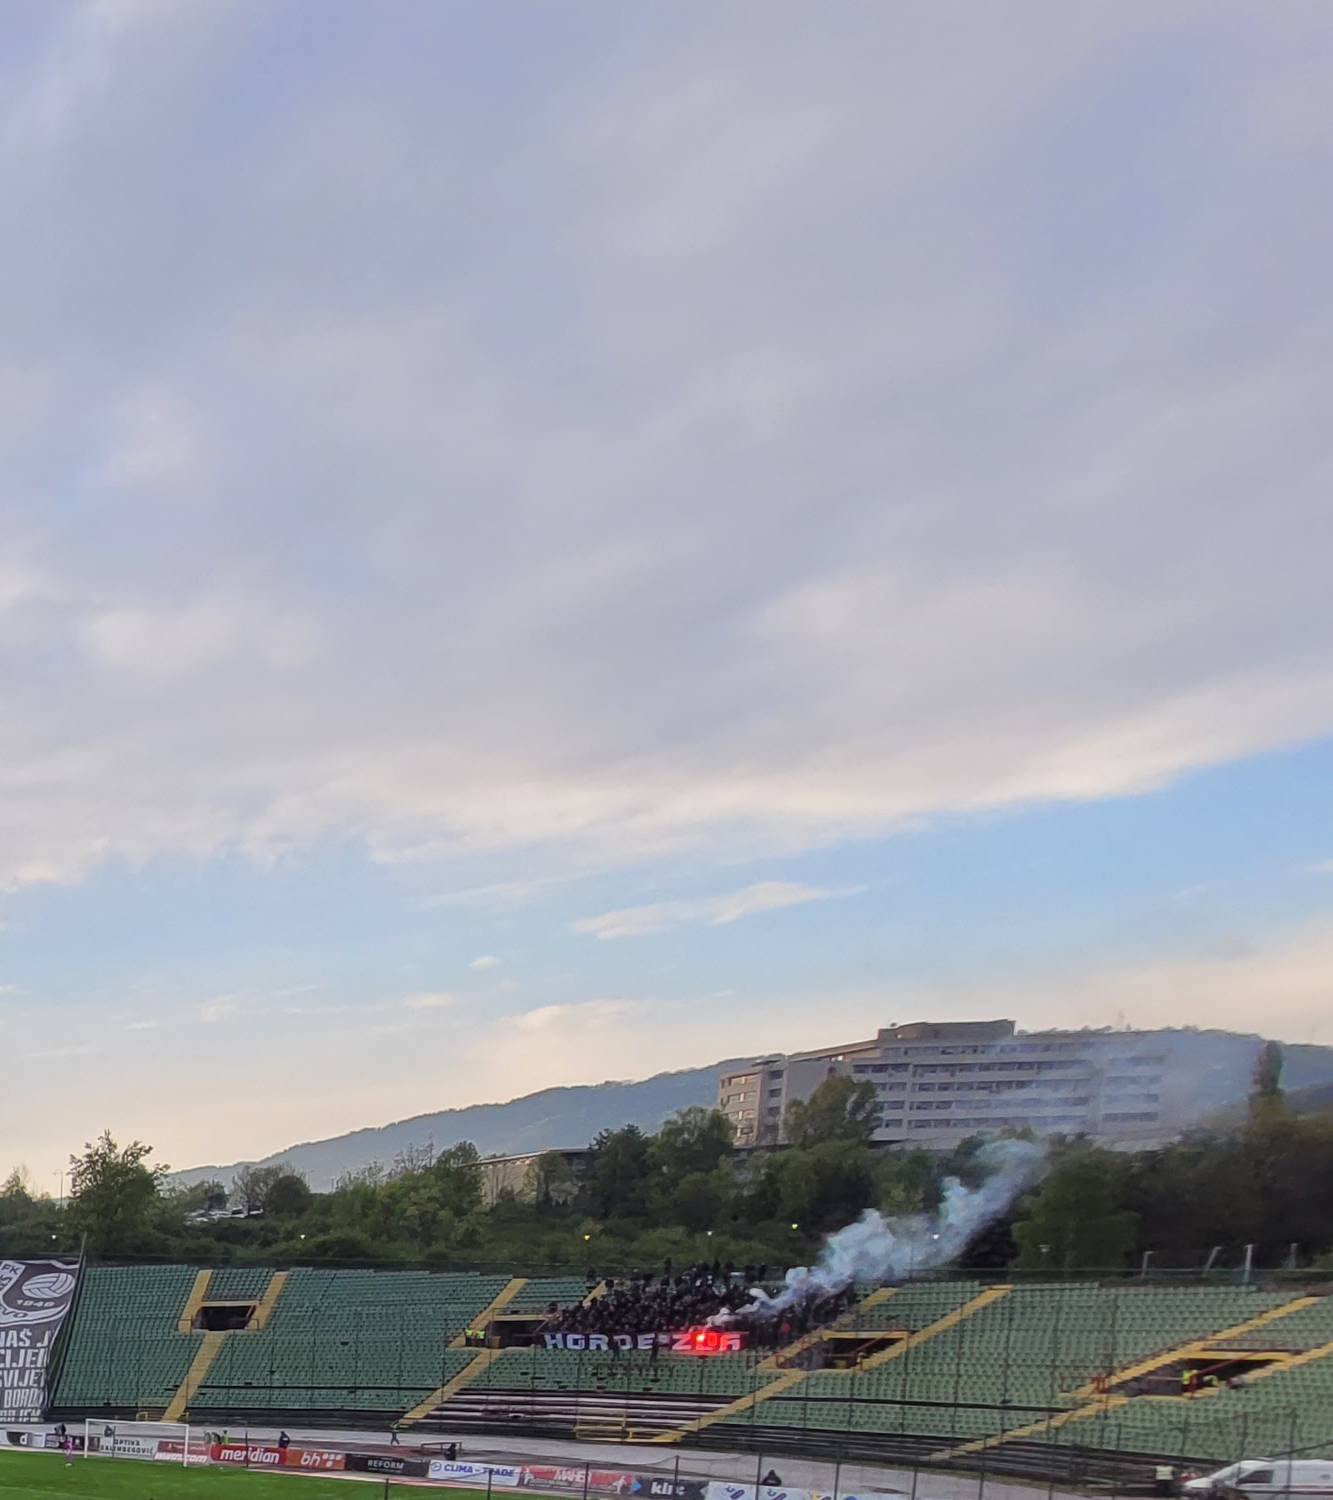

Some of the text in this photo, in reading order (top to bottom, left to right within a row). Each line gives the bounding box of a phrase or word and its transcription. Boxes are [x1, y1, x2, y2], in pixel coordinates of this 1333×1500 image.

[36, 1330, 53, 1347] J
[544, 1333, 655, 1350] HORDE
[219, 1447, 280, 1464] meridian
[367, 1459, 405, 1469] REFORM
[444, 1464, 473, 1473] CLIMA
